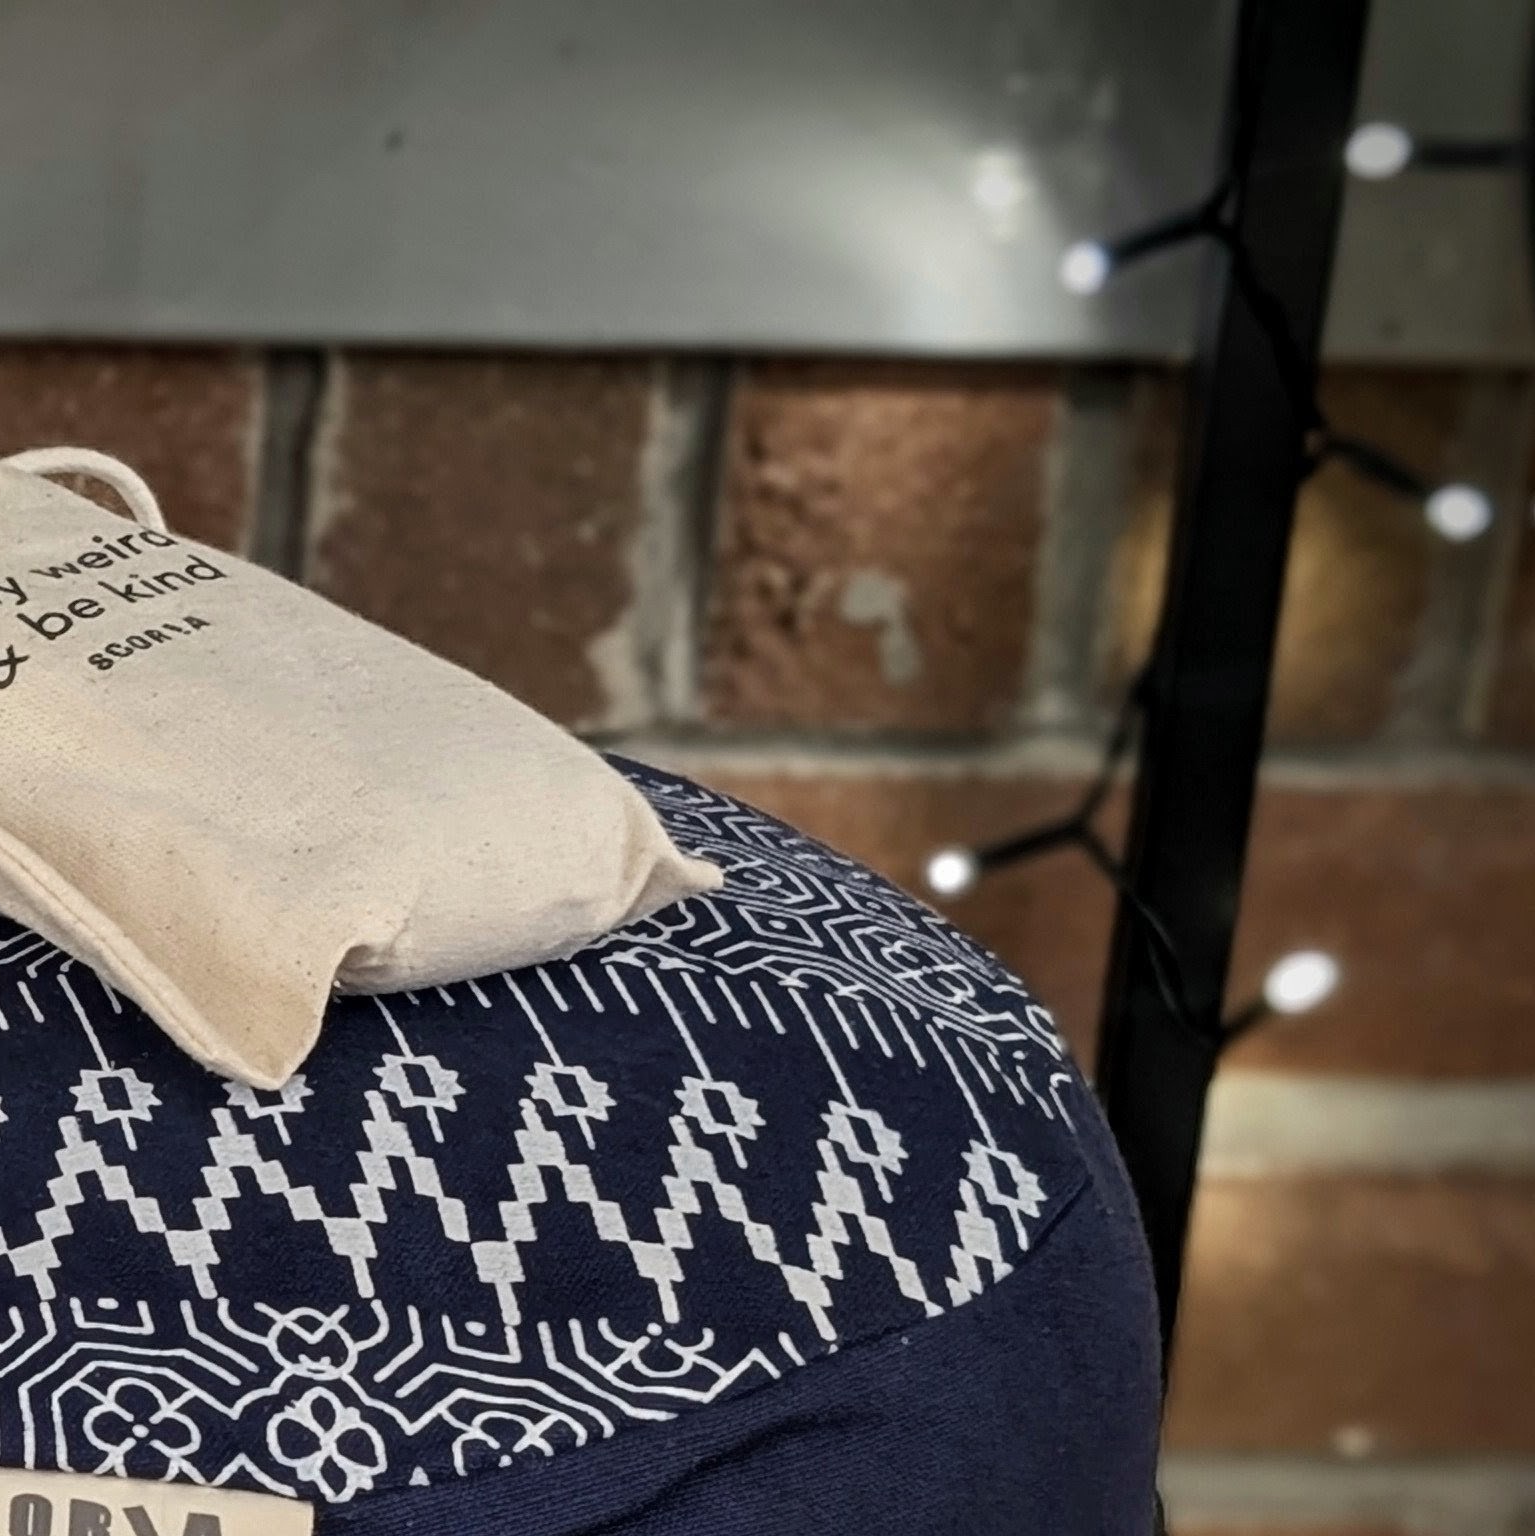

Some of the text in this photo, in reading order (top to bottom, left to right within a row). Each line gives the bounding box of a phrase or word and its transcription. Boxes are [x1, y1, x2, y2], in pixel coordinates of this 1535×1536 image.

[29, 529, 178, 579] weird
[16, 598, 105, 640] be
[98, 554, 227, 603] kind
